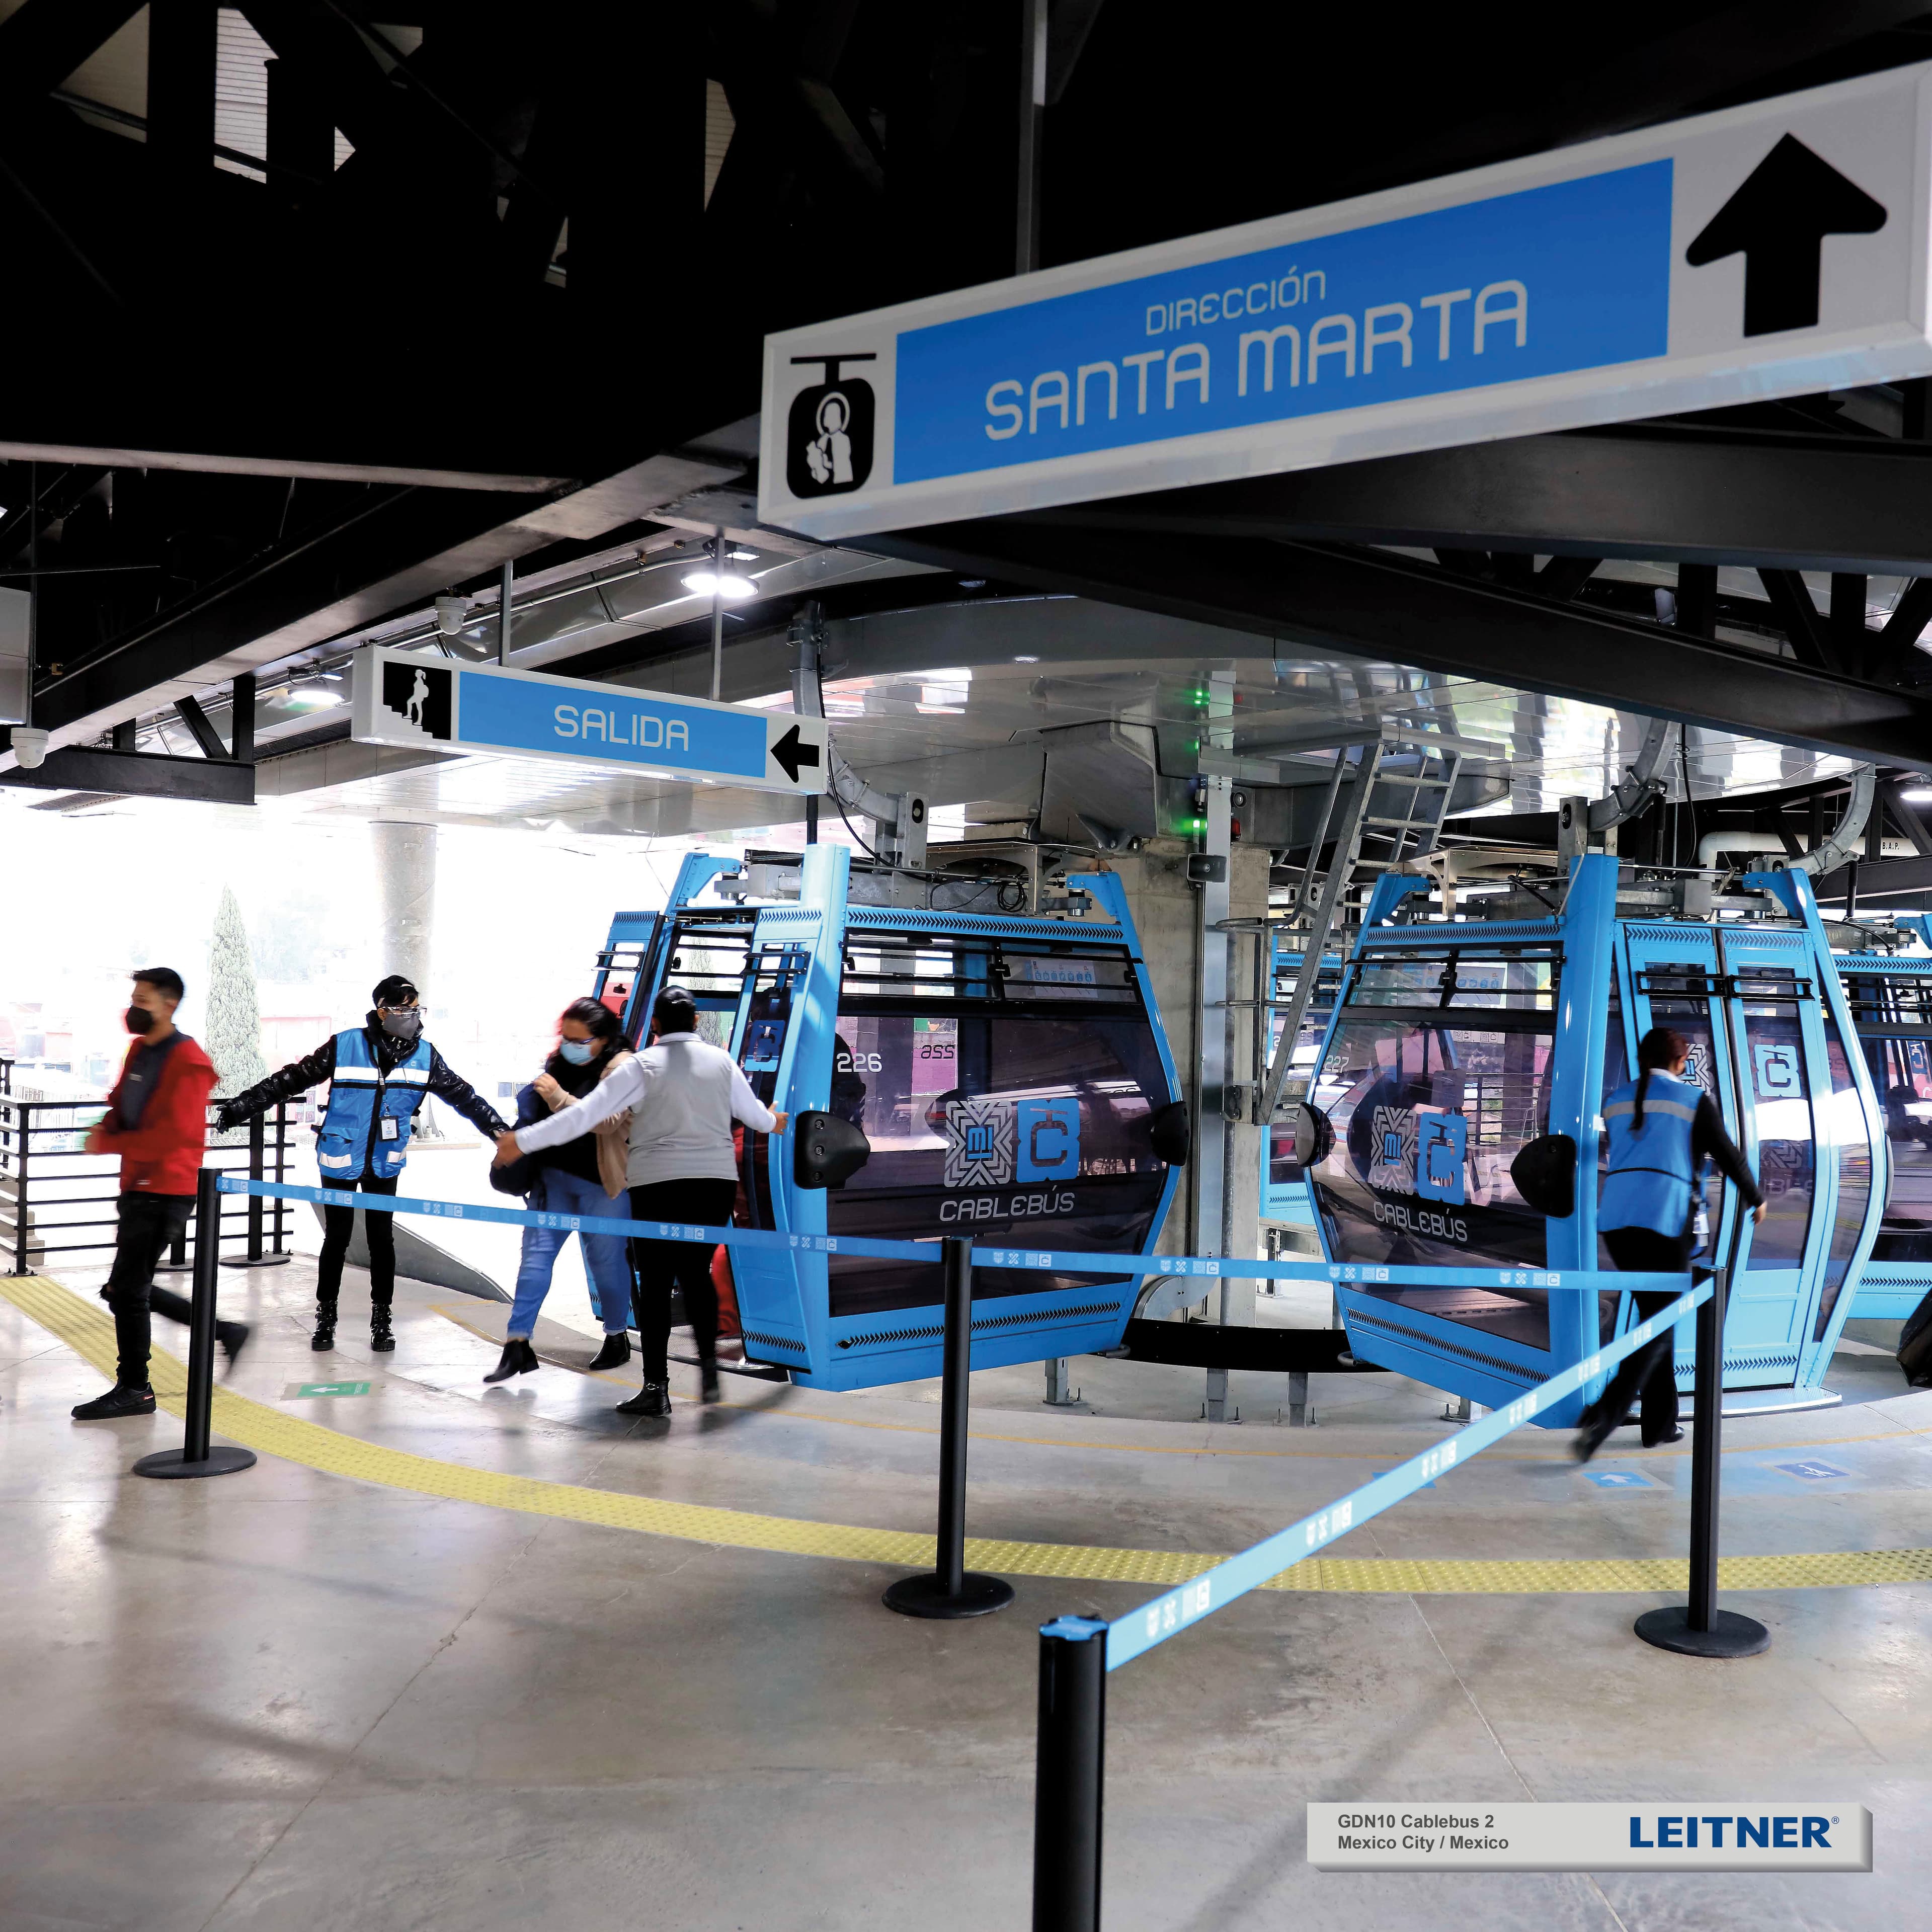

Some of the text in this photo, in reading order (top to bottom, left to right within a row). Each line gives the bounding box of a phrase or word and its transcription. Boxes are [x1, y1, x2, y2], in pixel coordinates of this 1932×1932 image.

[985, 279, 1528, 441] SANTA MARTA
[553, 704, 689, 752] SALIDA
[1882, 842, 1899, 850] B.A.P.
[836, 1053, 882, 1073] 226
[1324, 1055, 1349, 1073] 227
[939, 1185, 1075, 1222] CABLEBÚS
[1373, 1201, 1468, 1242] CABLEBÚS
